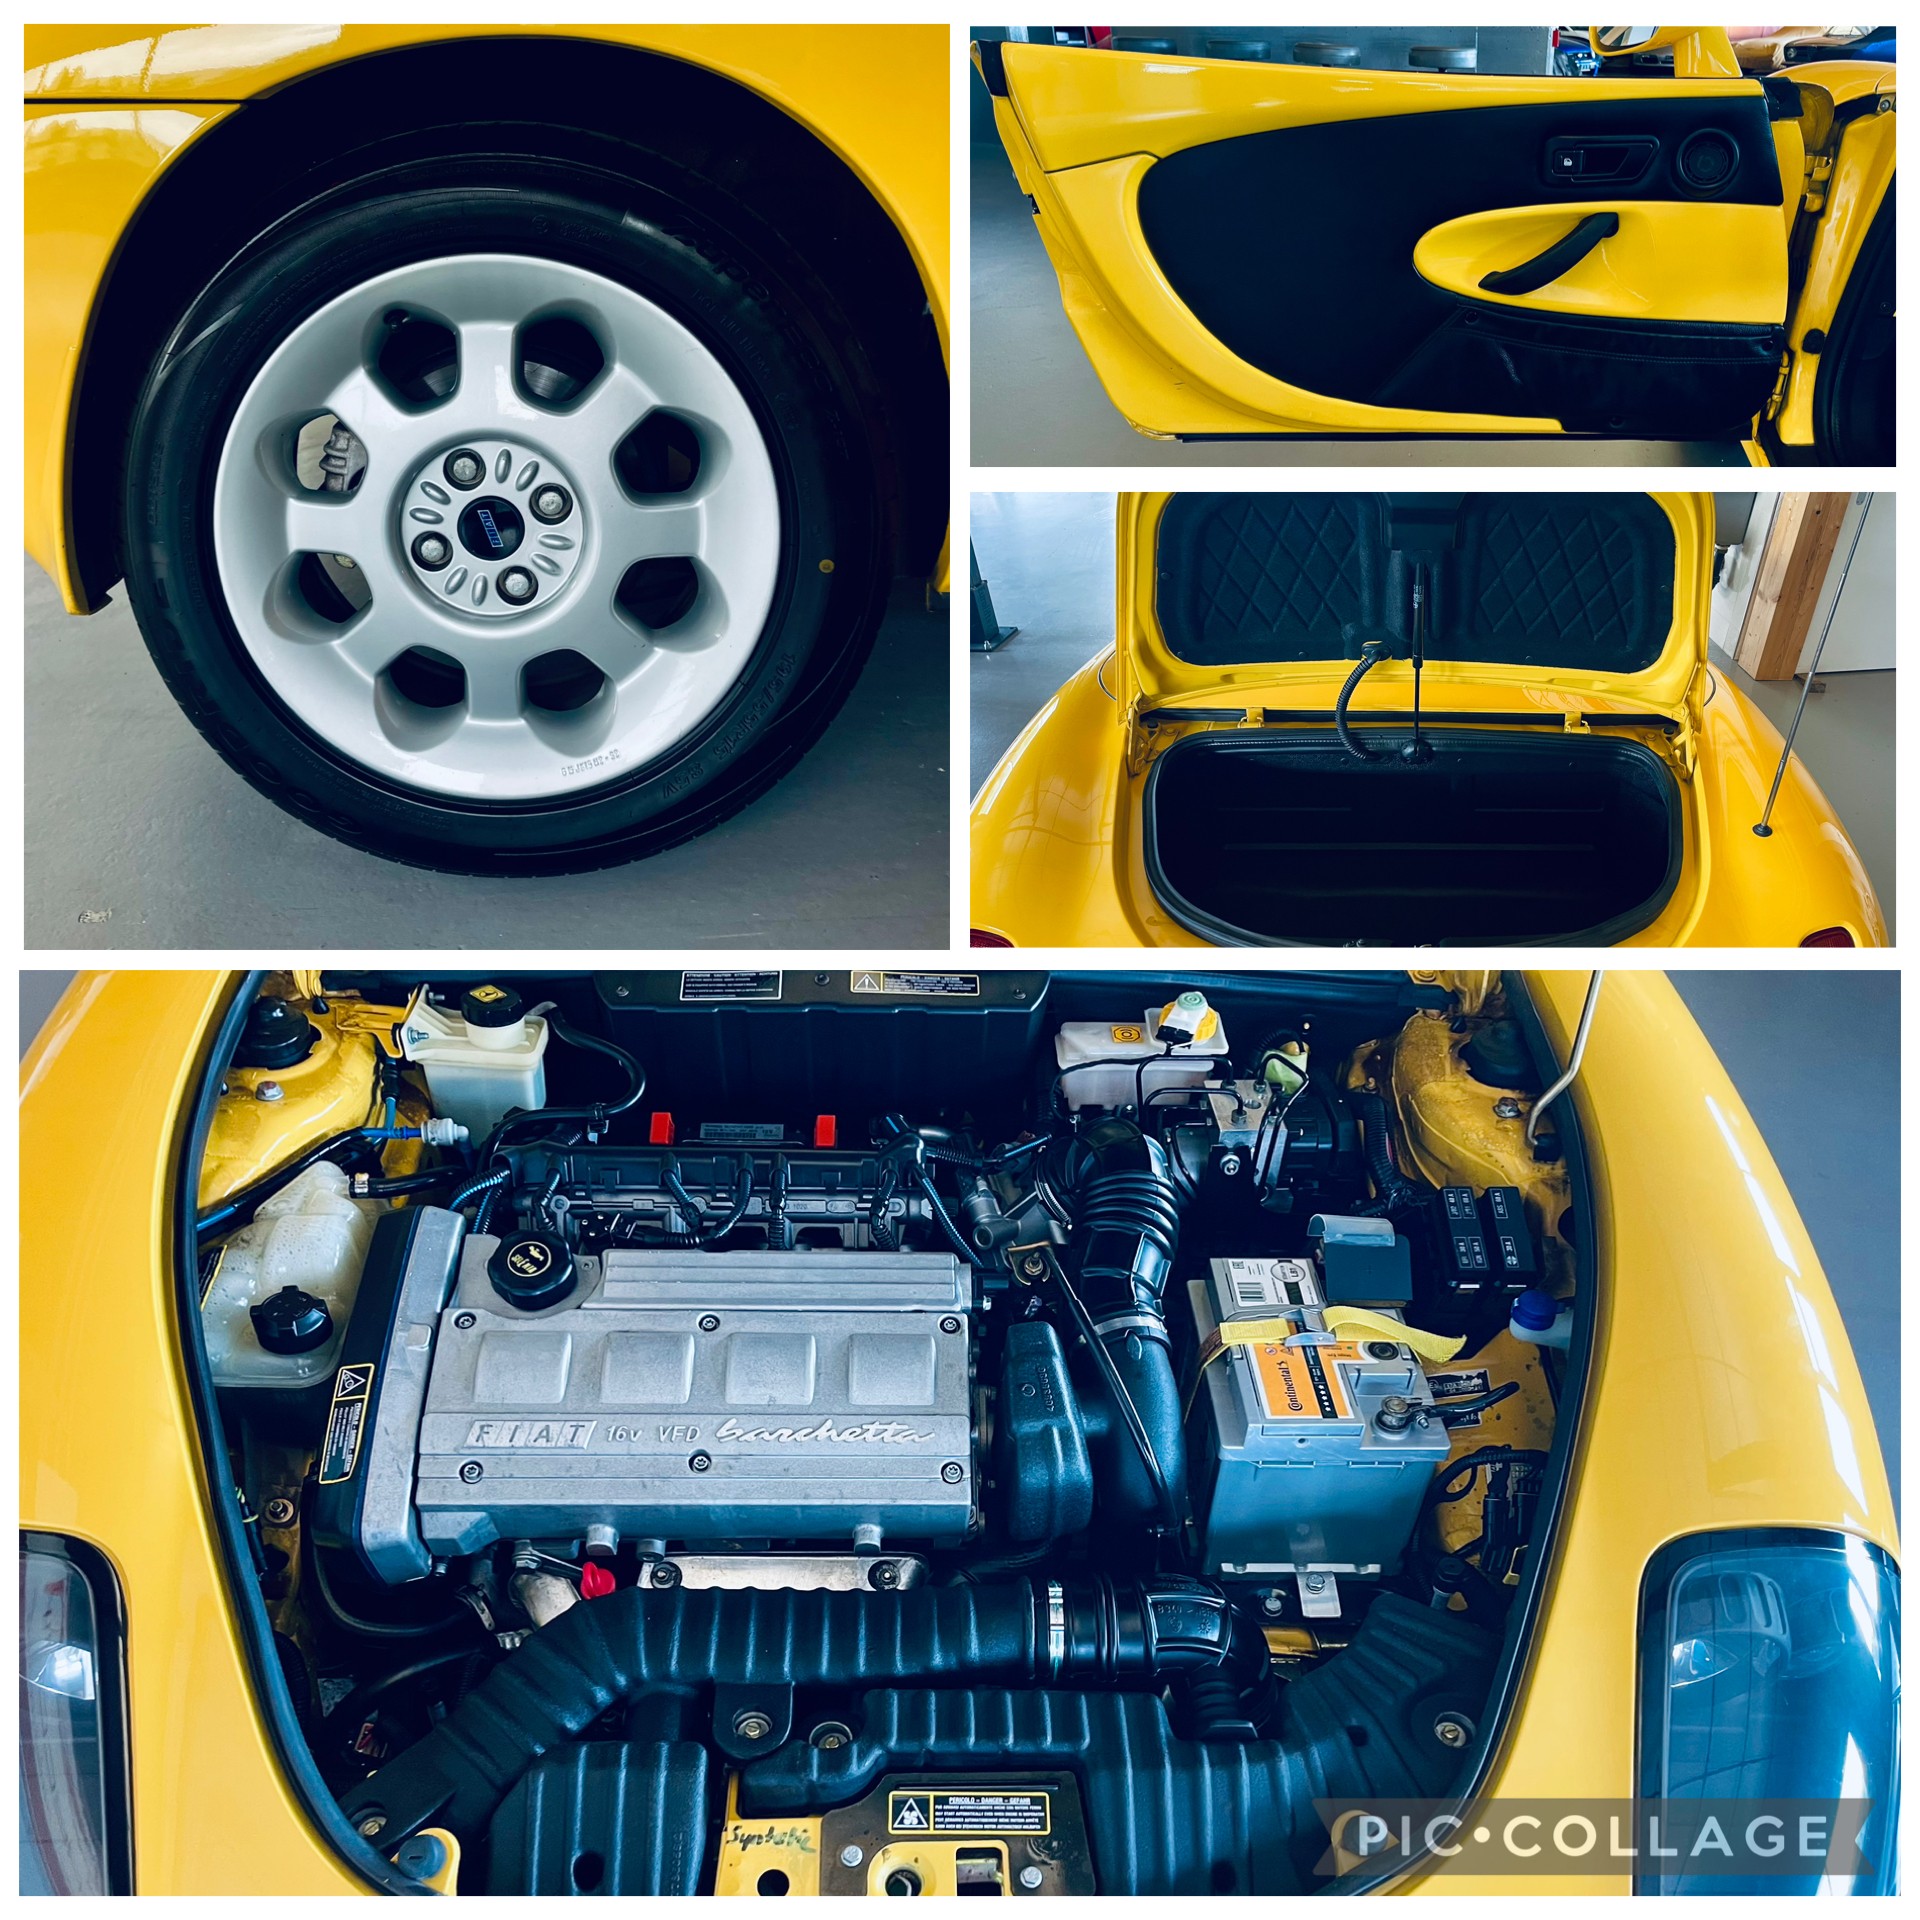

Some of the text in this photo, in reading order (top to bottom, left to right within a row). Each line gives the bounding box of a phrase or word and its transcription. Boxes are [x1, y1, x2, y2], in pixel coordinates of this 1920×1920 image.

[481, 512, 500, 545] FIAT
[1278, 1366, 1303, 1411] Continental
[470, 1418, 938, 1446] FIAT 16v VFD barchetta
